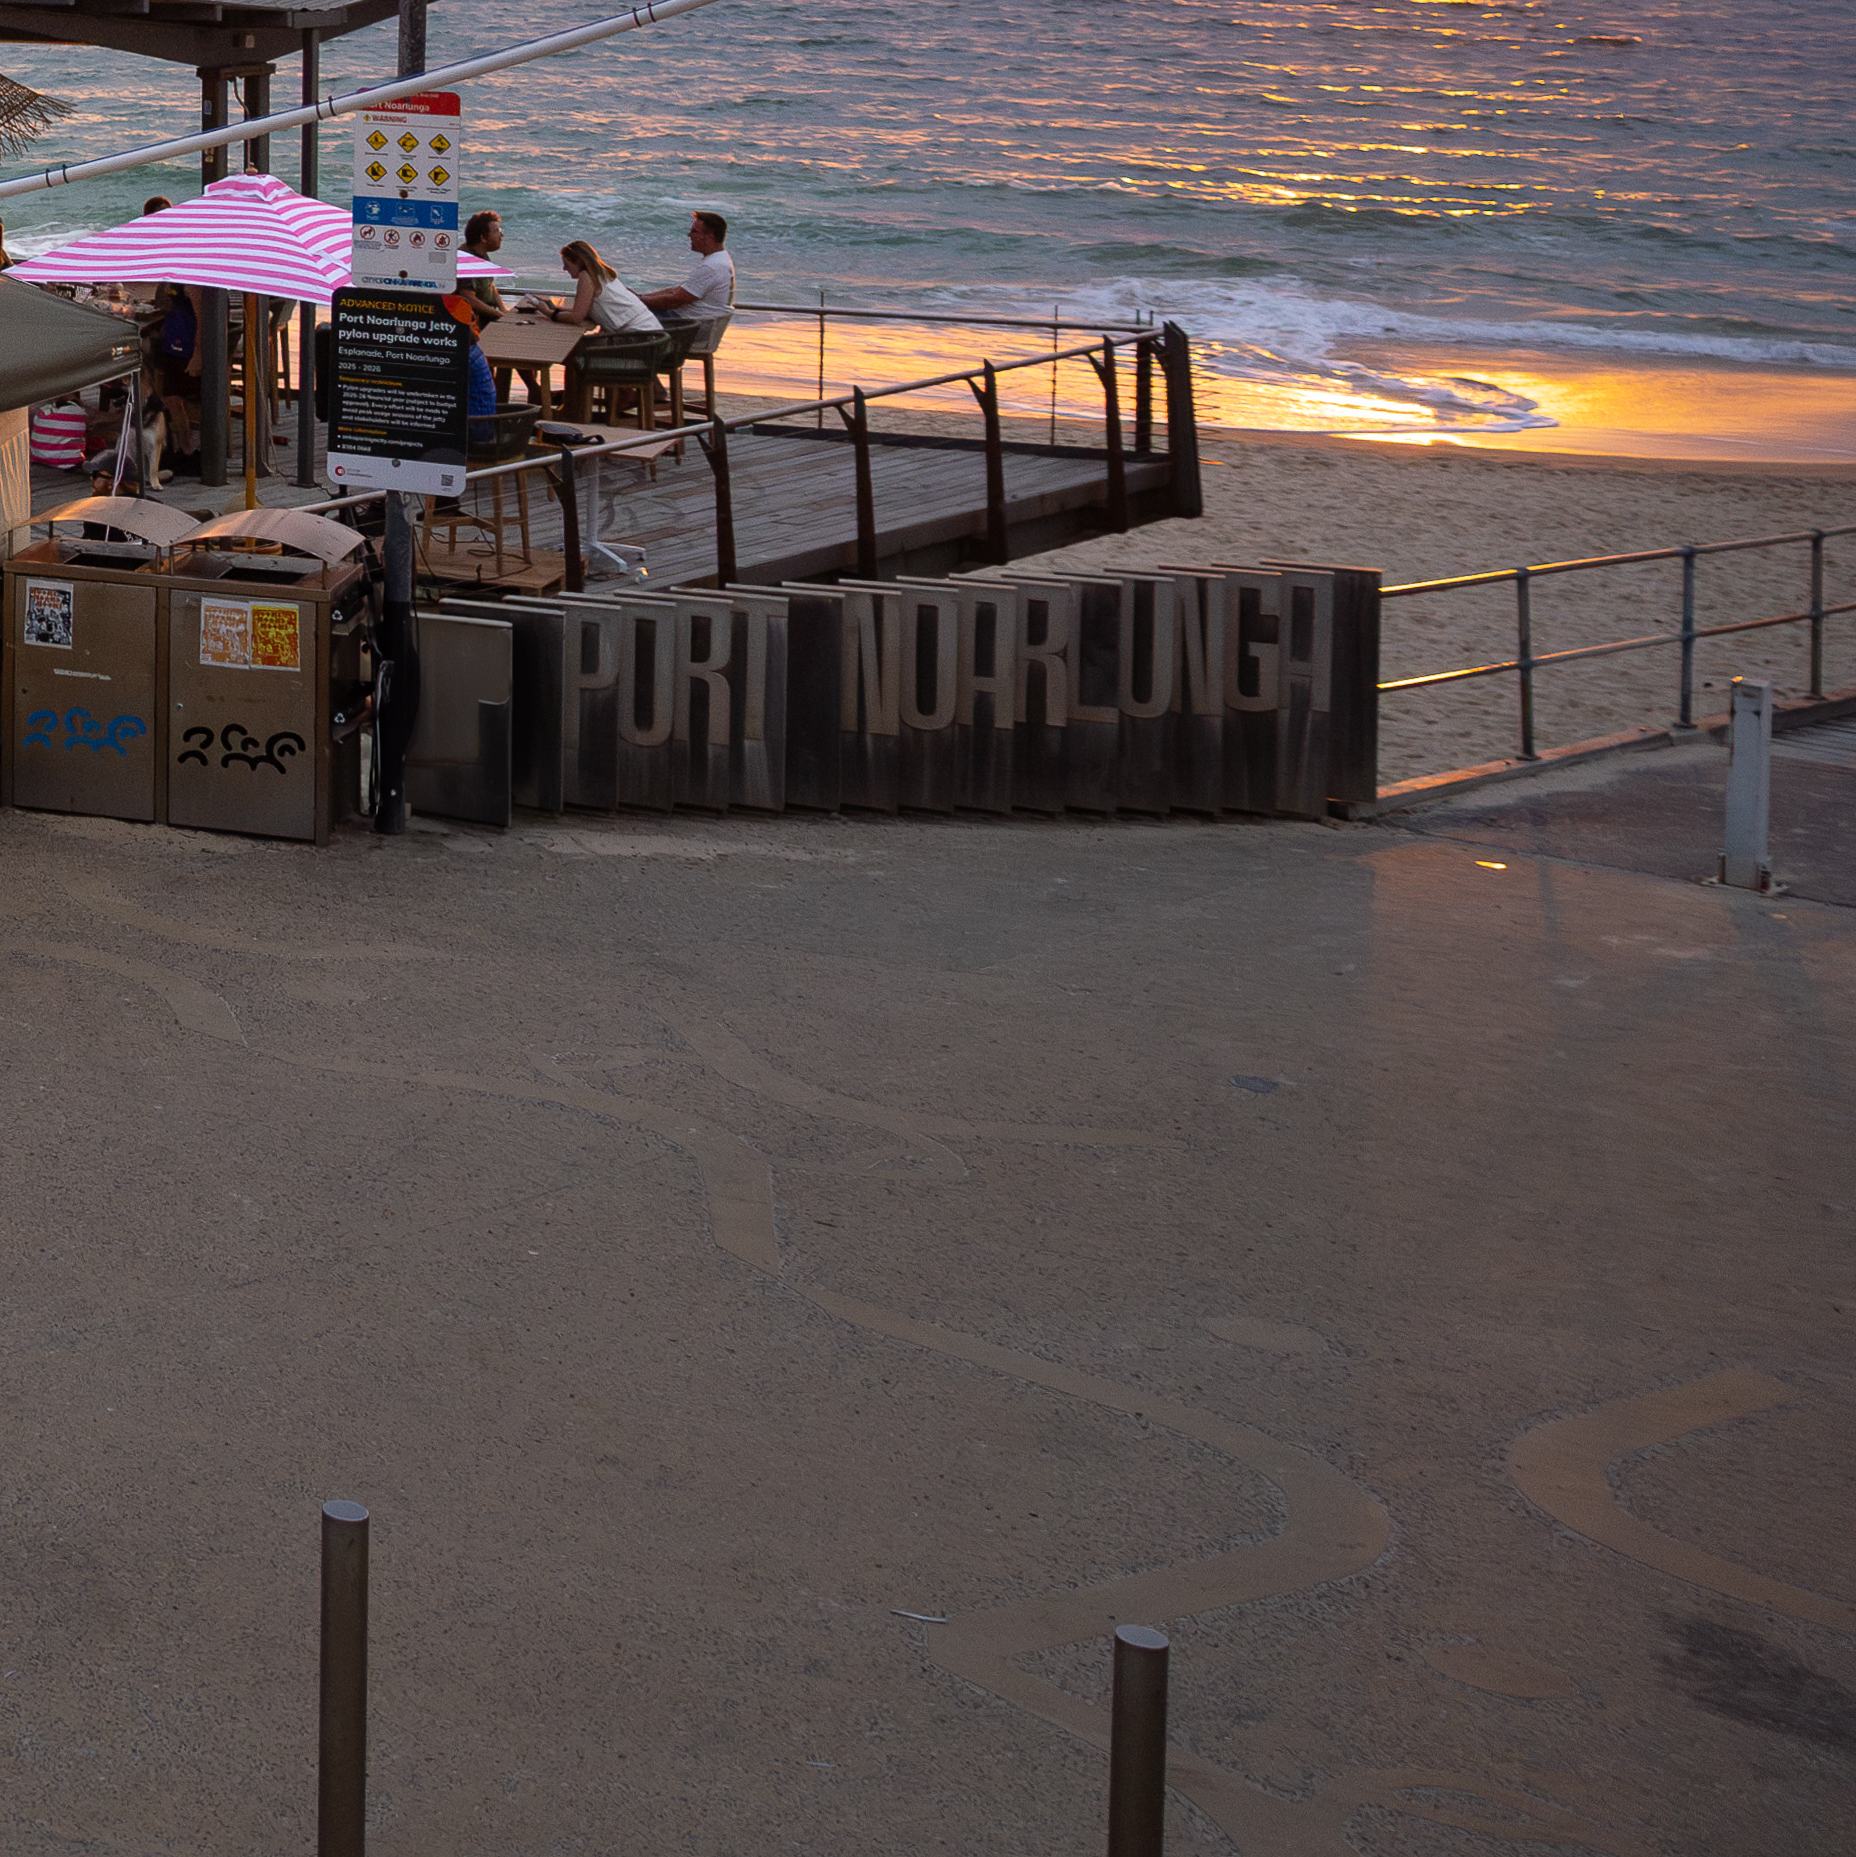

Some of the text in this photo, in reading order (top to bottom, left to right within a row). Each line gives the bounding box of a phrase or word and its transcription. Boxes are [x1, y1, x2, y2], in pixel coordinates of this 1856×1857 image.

[385, 101, 430, 113] Noarlunga
[339, 298, 435, 314] ADVANCED NOTICE
[339, 312, 456, 334] Port Noarlunga Jetty
[338, 328, 458, 347] pylon upgrade works
[338, 346, 451, 365] Esplanade, Port Noarlunga
[561, 572, 1335, 749] PORT NOARLUNGA
